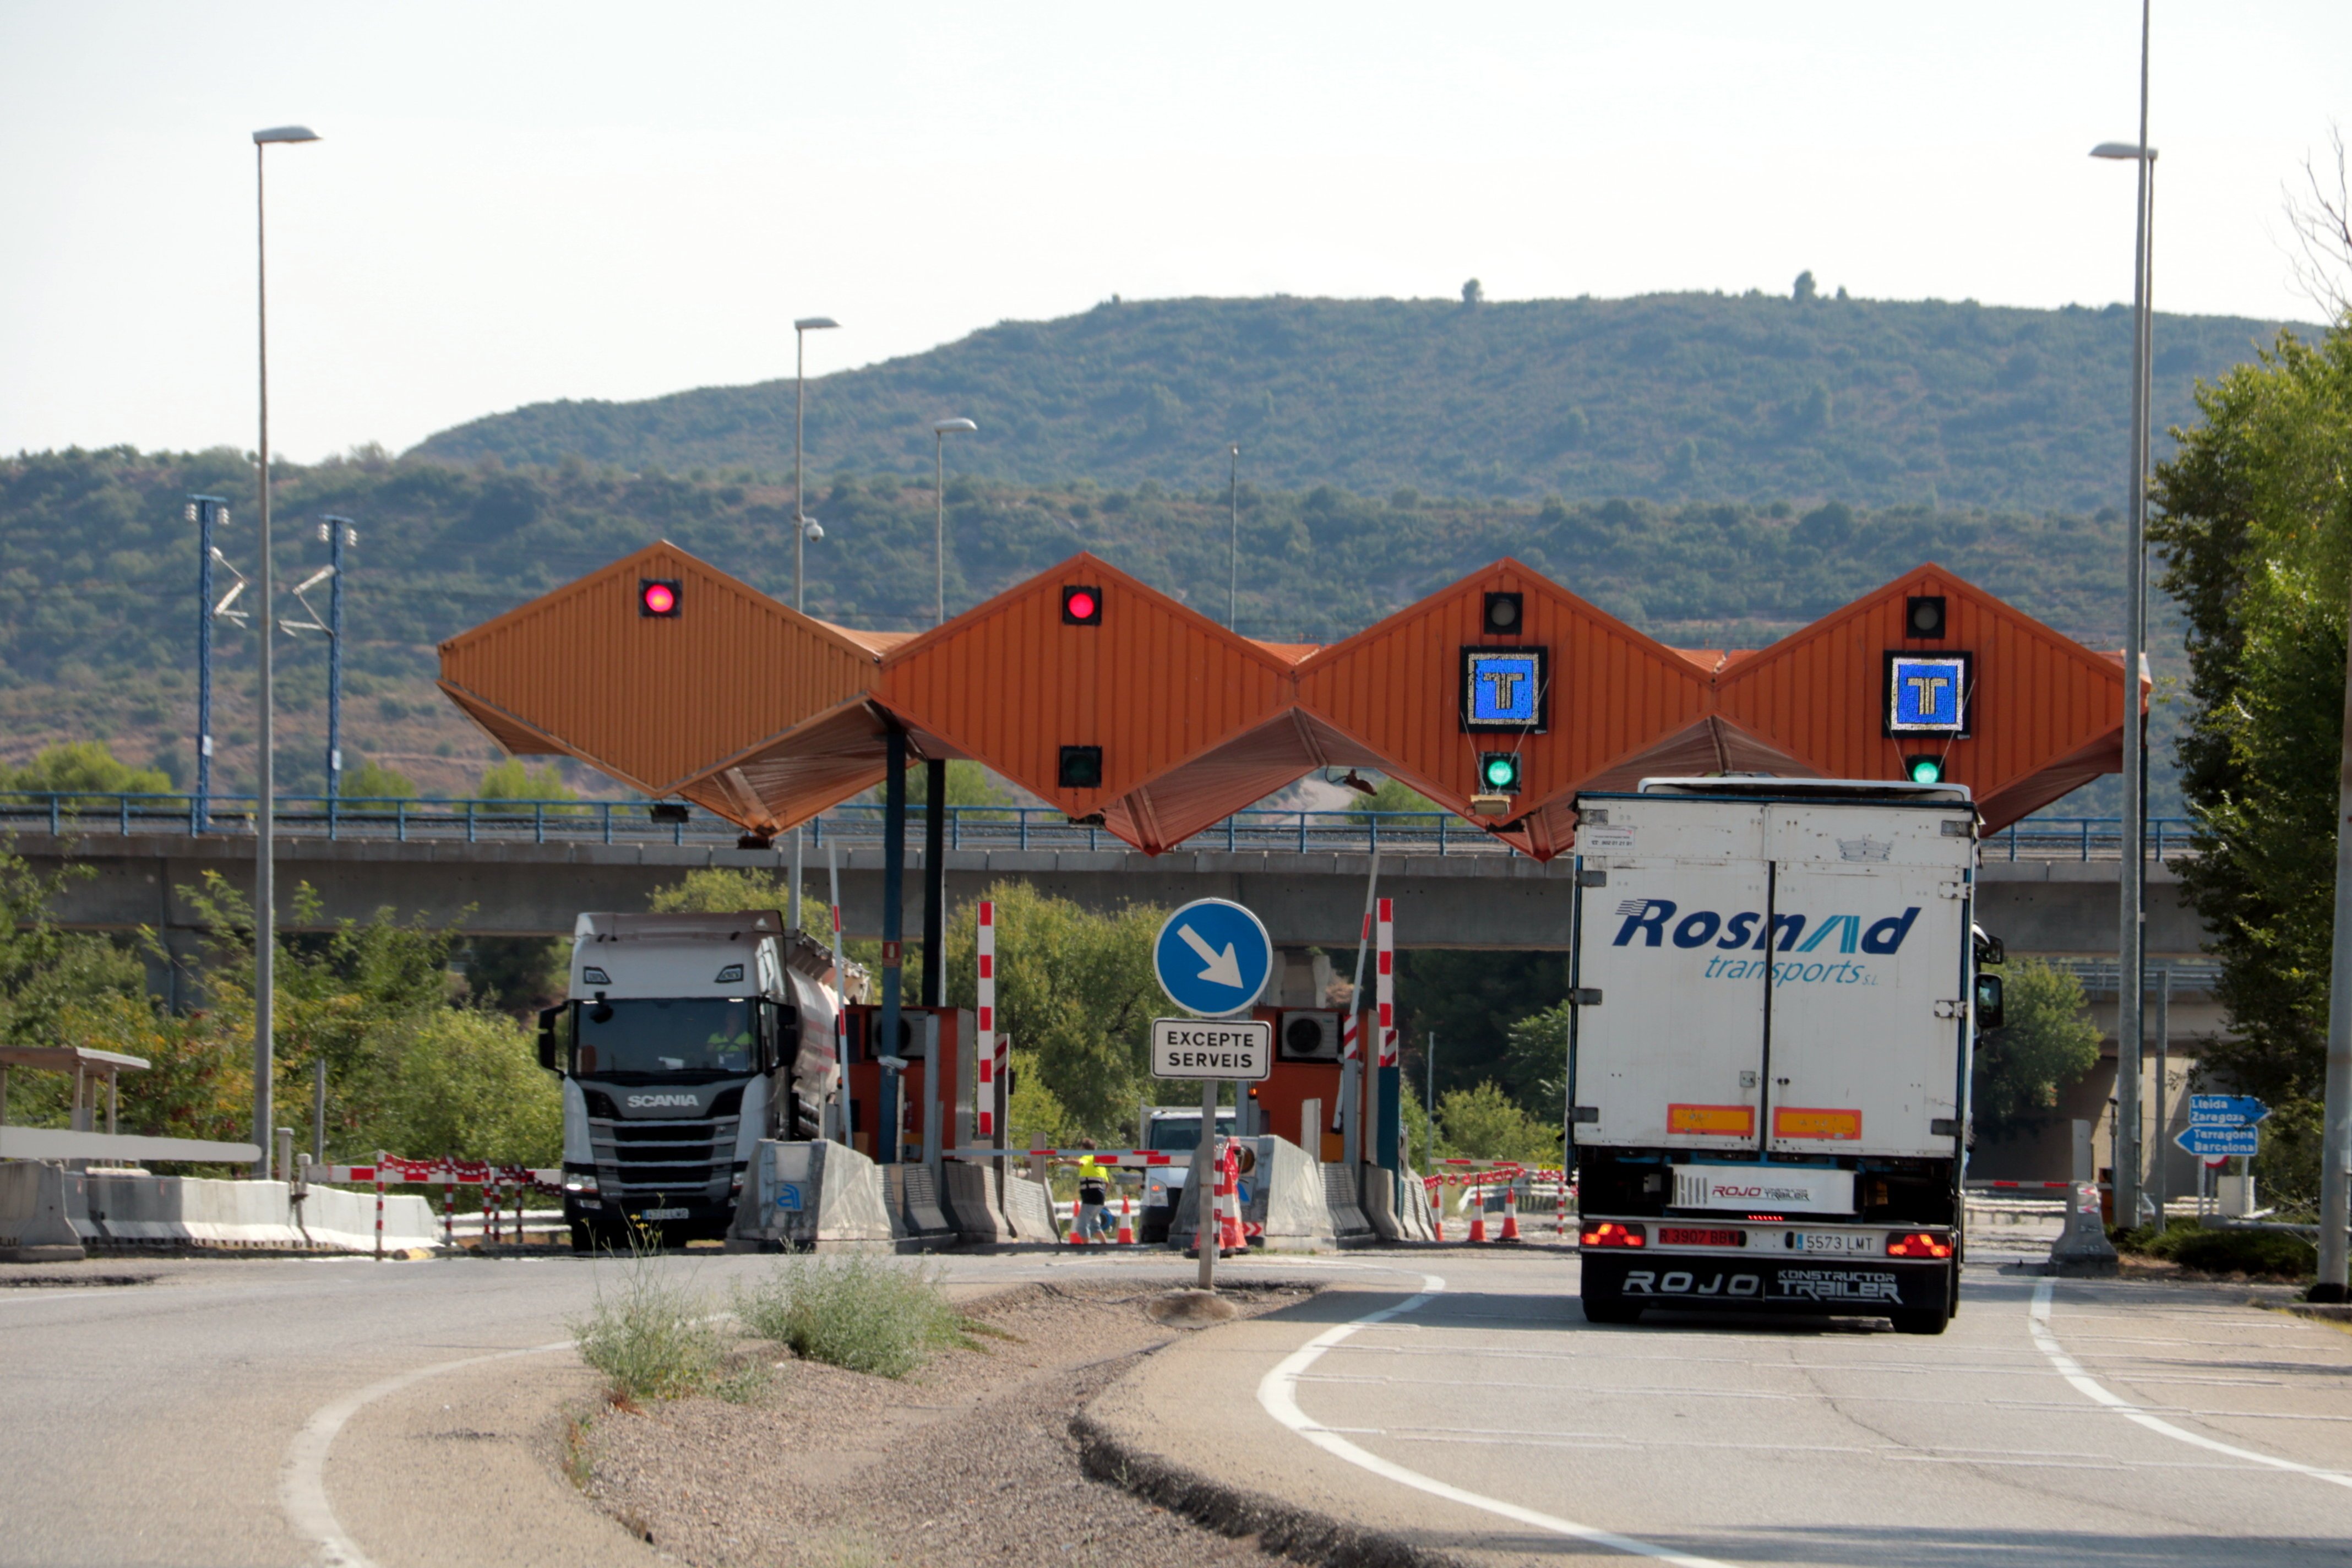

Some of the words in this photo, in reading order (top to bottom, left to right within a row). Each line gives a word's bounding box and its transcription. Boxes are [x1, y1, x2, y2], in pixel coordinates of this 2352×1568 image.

[1705, 955, 1865, 988] transports
[1167, 1031, 1254, 1047] EXCEPTE
[1168, 1053, 1253, 1068] SERVEIS
[627, 1094, 699, 1108] SCANIA
[2191, 1099, 2228, 1109] Lleida
[2191, 1112, 2246, 1123] Zaragoza
[2193, 1129, 2255, 1140] Tarragona
[2194, 1141, 2255, 1152] Barcelona
[1712, 1186, 1762, 1197] ROJO
[1659, 1229, 1668, 1243] R
[1673, 1229, 1706, 1243] 3907
[1807, 1236, 1842, 1249] 5573
[1847, 1237, 1873, 1250] LMT
[1622, 1271, 1760, 1294] ROJO
[1777, 1270, 1896, 1282] KONSTRUCTOR
[1777, 1280, 1903, 1304] TRAILER
